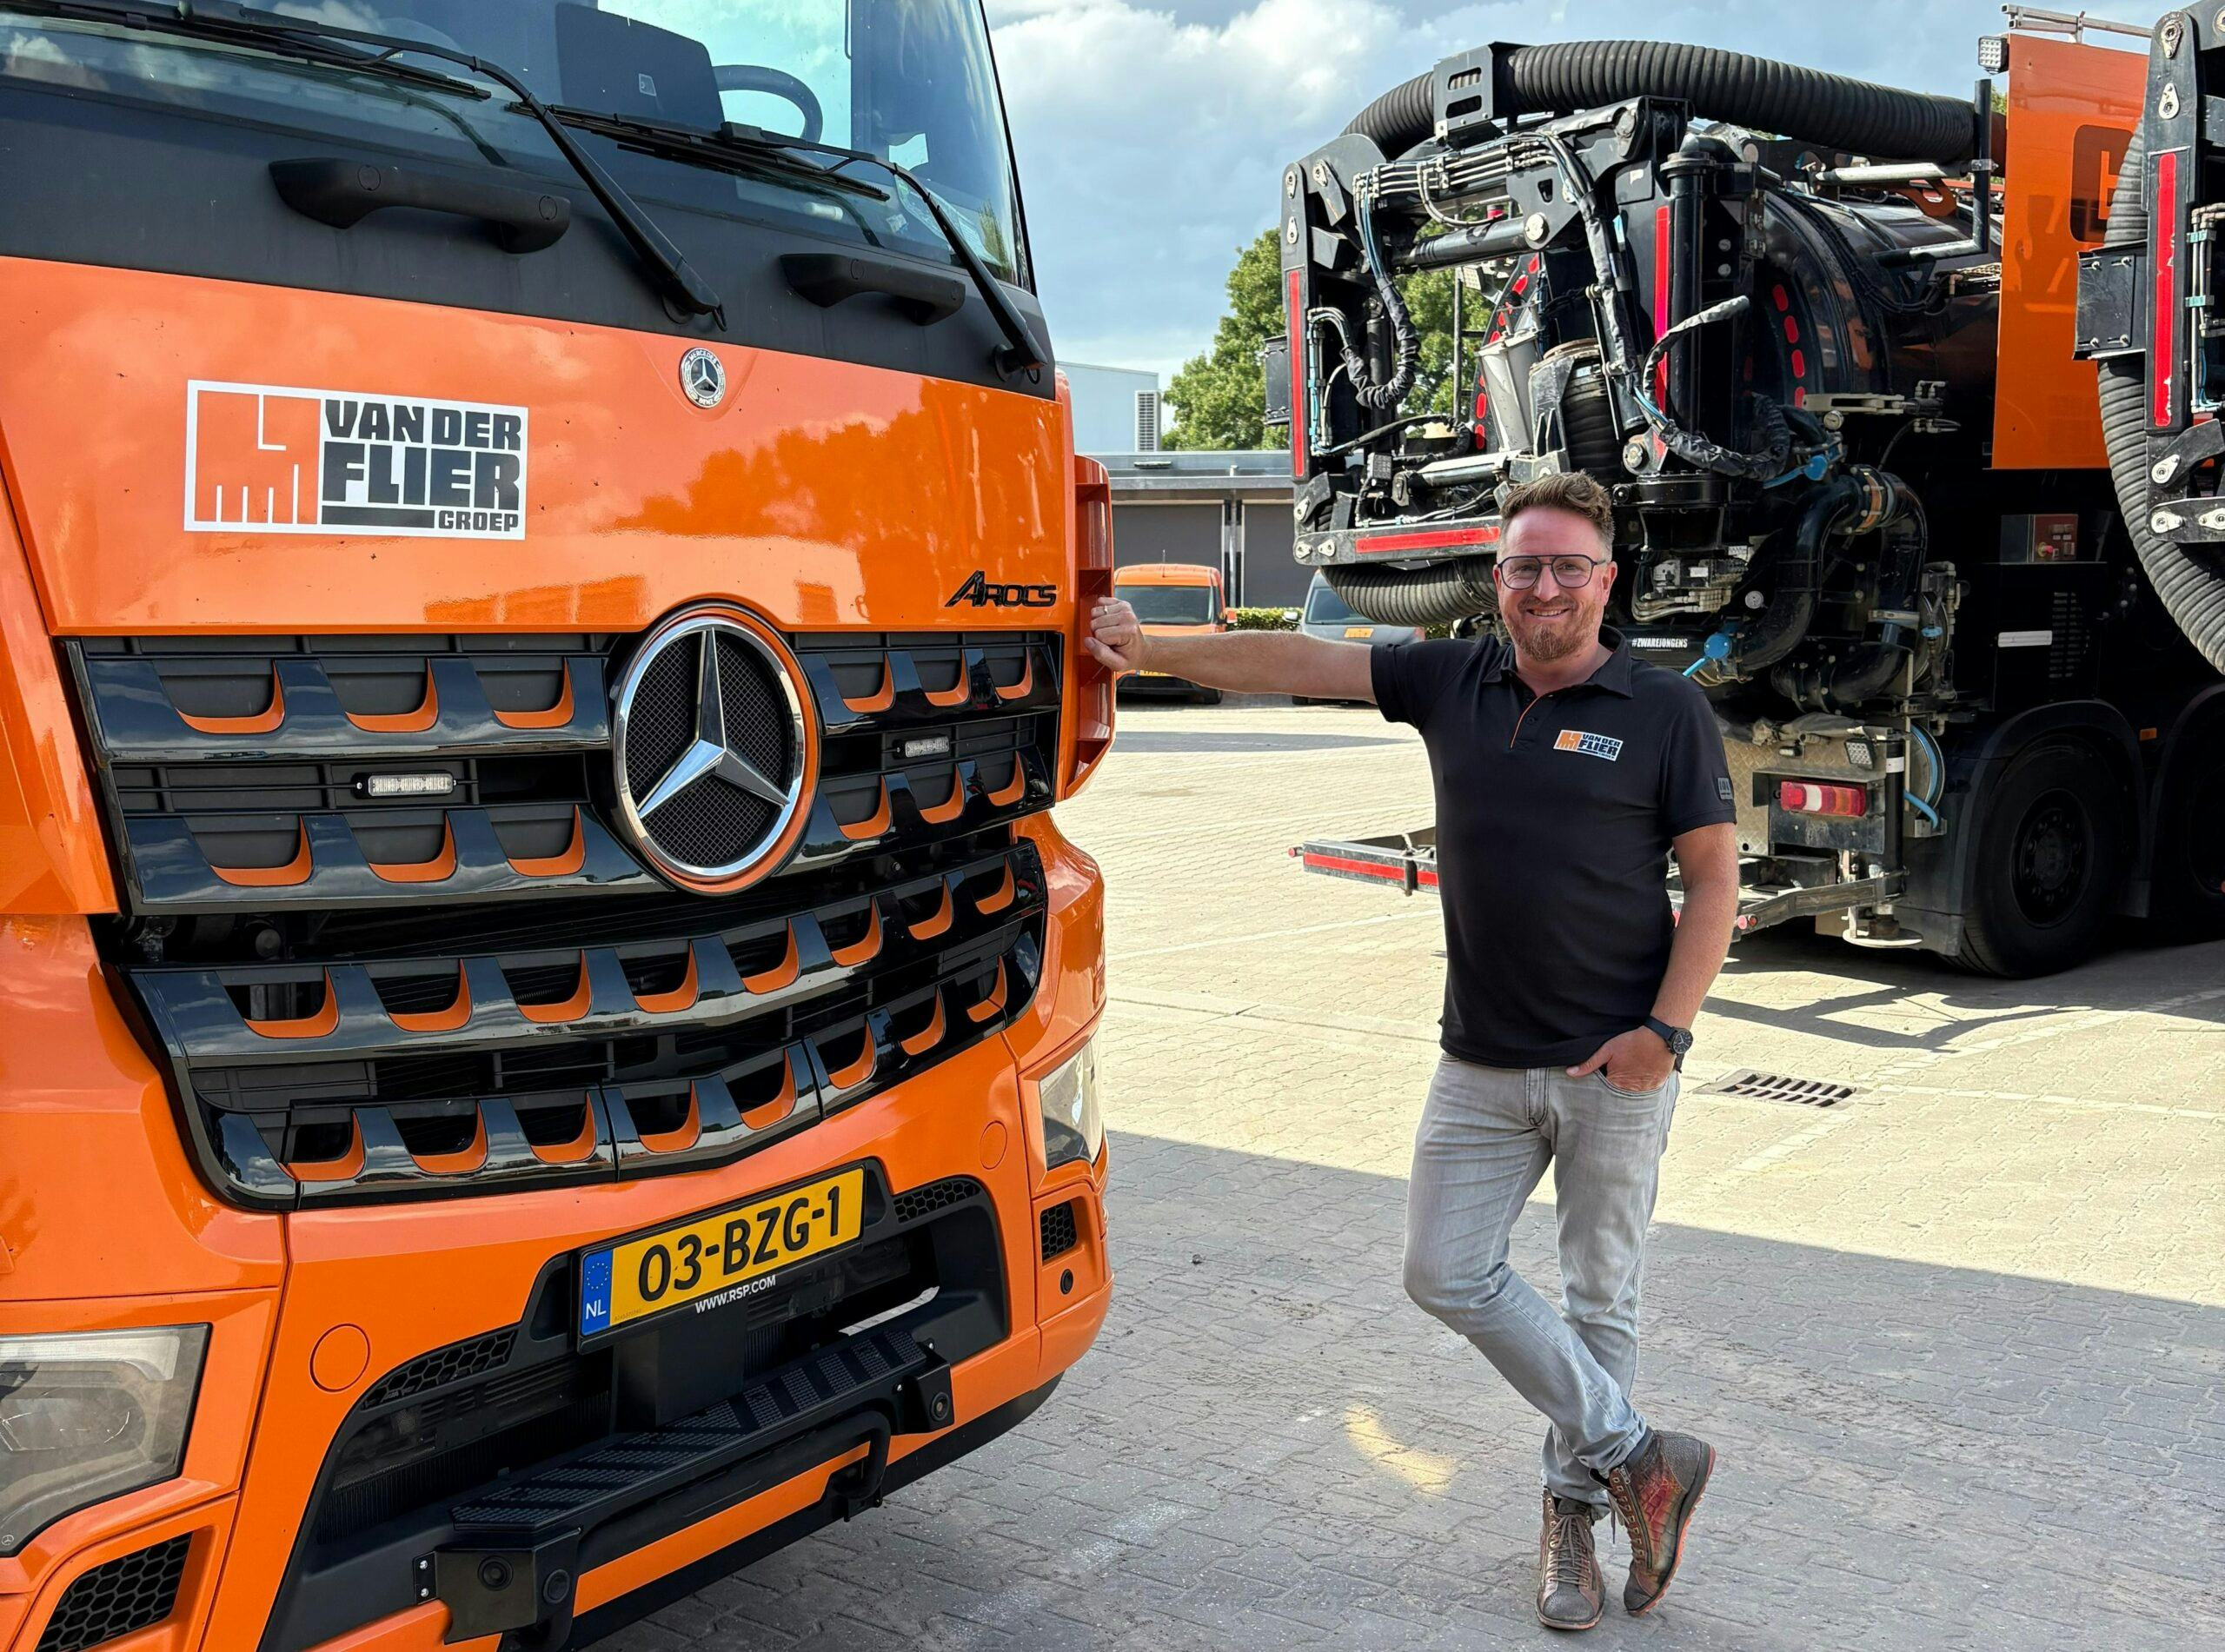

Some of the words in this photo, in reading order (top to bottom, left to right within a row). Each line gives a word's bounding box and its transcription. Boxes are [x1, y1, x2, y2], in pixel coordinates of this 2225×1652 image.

[325, 399, 425, 443] VAN
[431, 408, 521, 450] DER
[322, 441, 521, 510] FLIER
[438, 510, 519, 532] GROEP
[1631, 637, 1688, 648] #ZWAREJONGENS
[1578, 740, 1618, 756] FLIER
[1583, 733, 1602, 742] VAN
[1602, 738, 1621, 747] DER
[639, 1185, 840, 1302] 03-BZG-1
[695, 1274, 776, 1314] WWW.RSP.COM
[585, 1299, 607, 1320] NL
